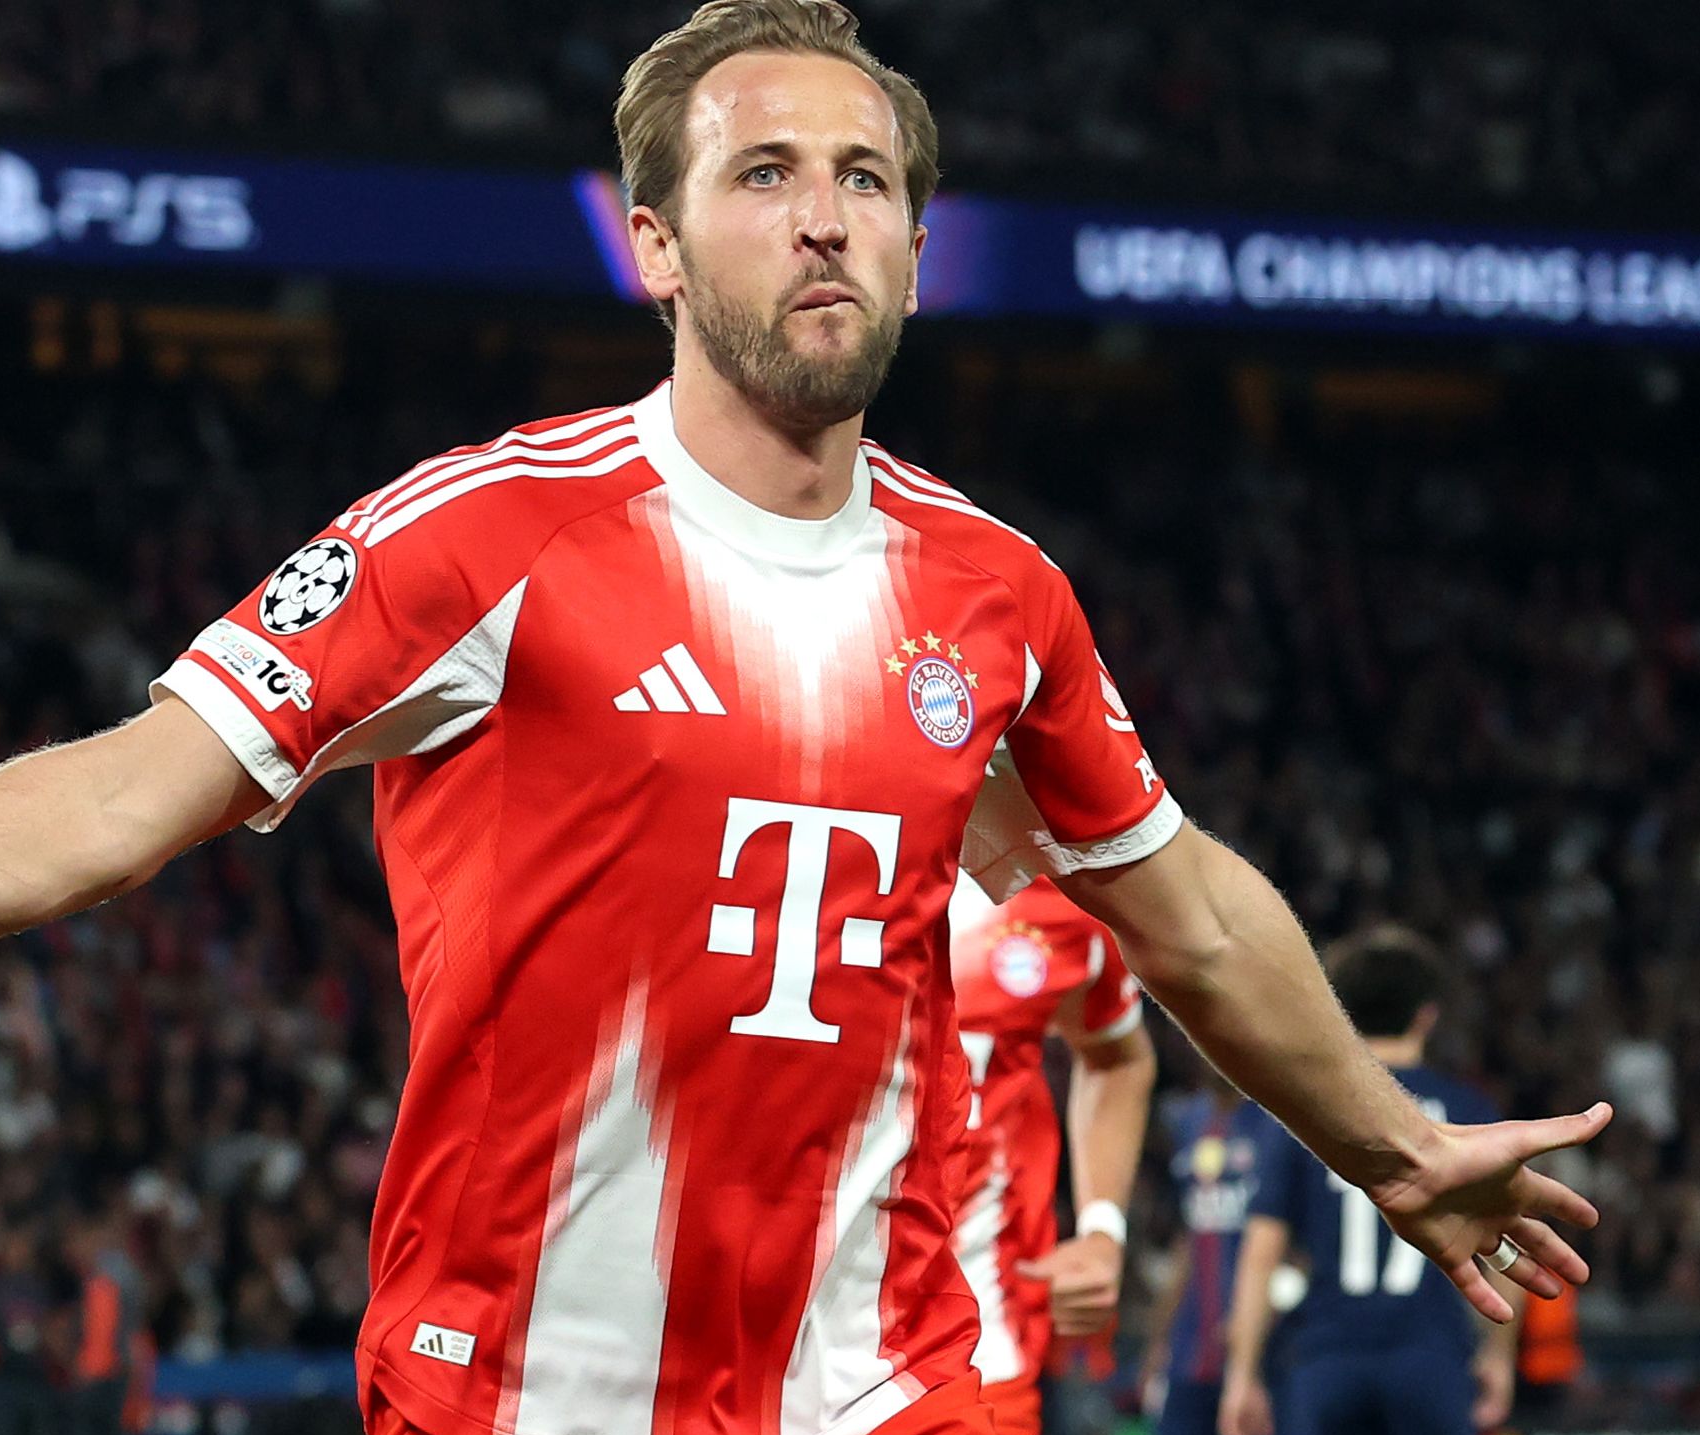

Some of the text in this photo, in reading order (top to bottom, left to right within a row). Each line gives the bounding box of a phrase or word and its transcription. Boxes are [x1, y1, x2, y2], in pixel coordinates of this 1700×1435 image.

[1074, 223, 1232, 303] UEFA
[1234, 231, 1582, 321] CHAMPIONS
[257, 659, 291, 695] 10
[911, 664, 966, 702] FC BAYERN
[717, 797, 902, 1044] T
